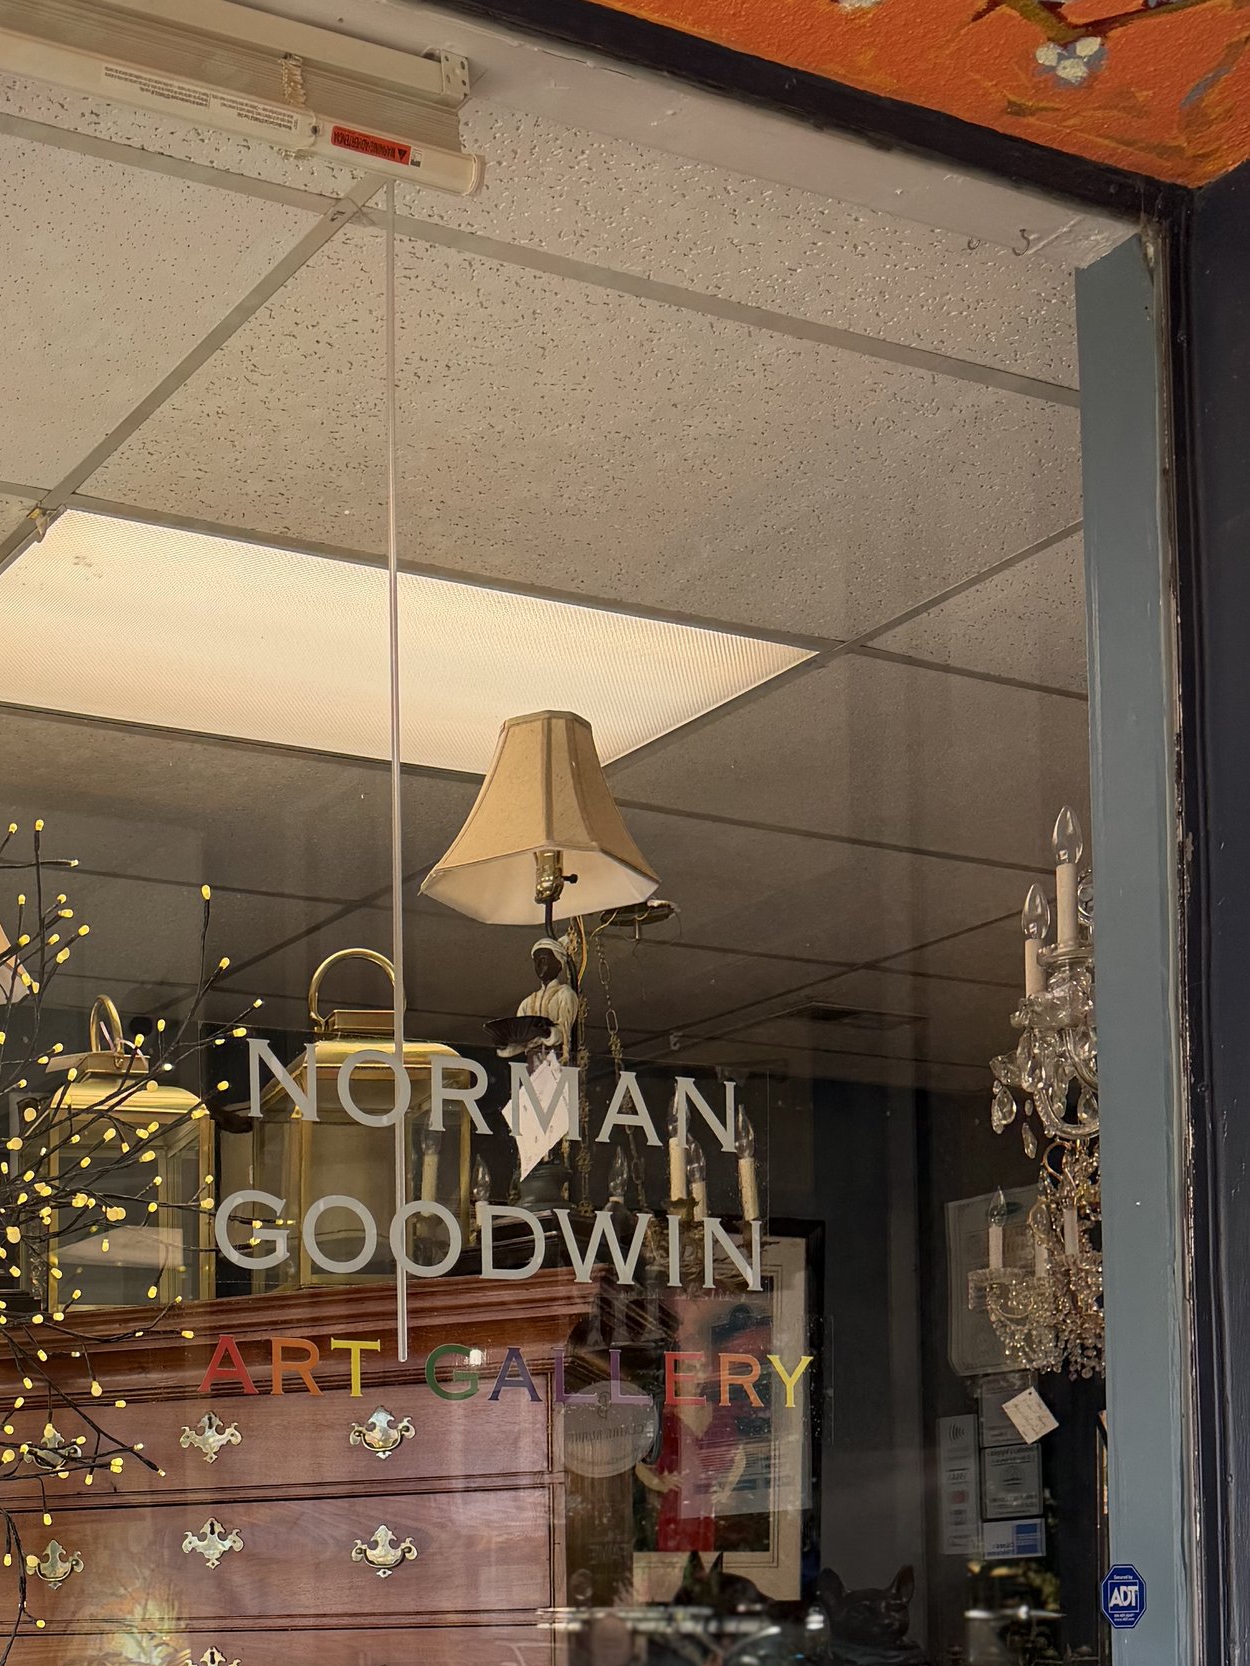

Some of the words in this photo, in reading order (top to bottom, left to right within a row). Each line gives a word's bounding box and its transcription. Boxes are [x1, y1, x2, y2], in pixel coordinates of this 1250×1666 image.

[246, 1038, 737, 1152] NORMAN
[214, 1189, 762, 1291] GOODWIN
[197, 1333, 381, 1397] ART
[425, 1343, 814, 1408] GALLERY
[1109, 1586, 1139, 1608] ADT
